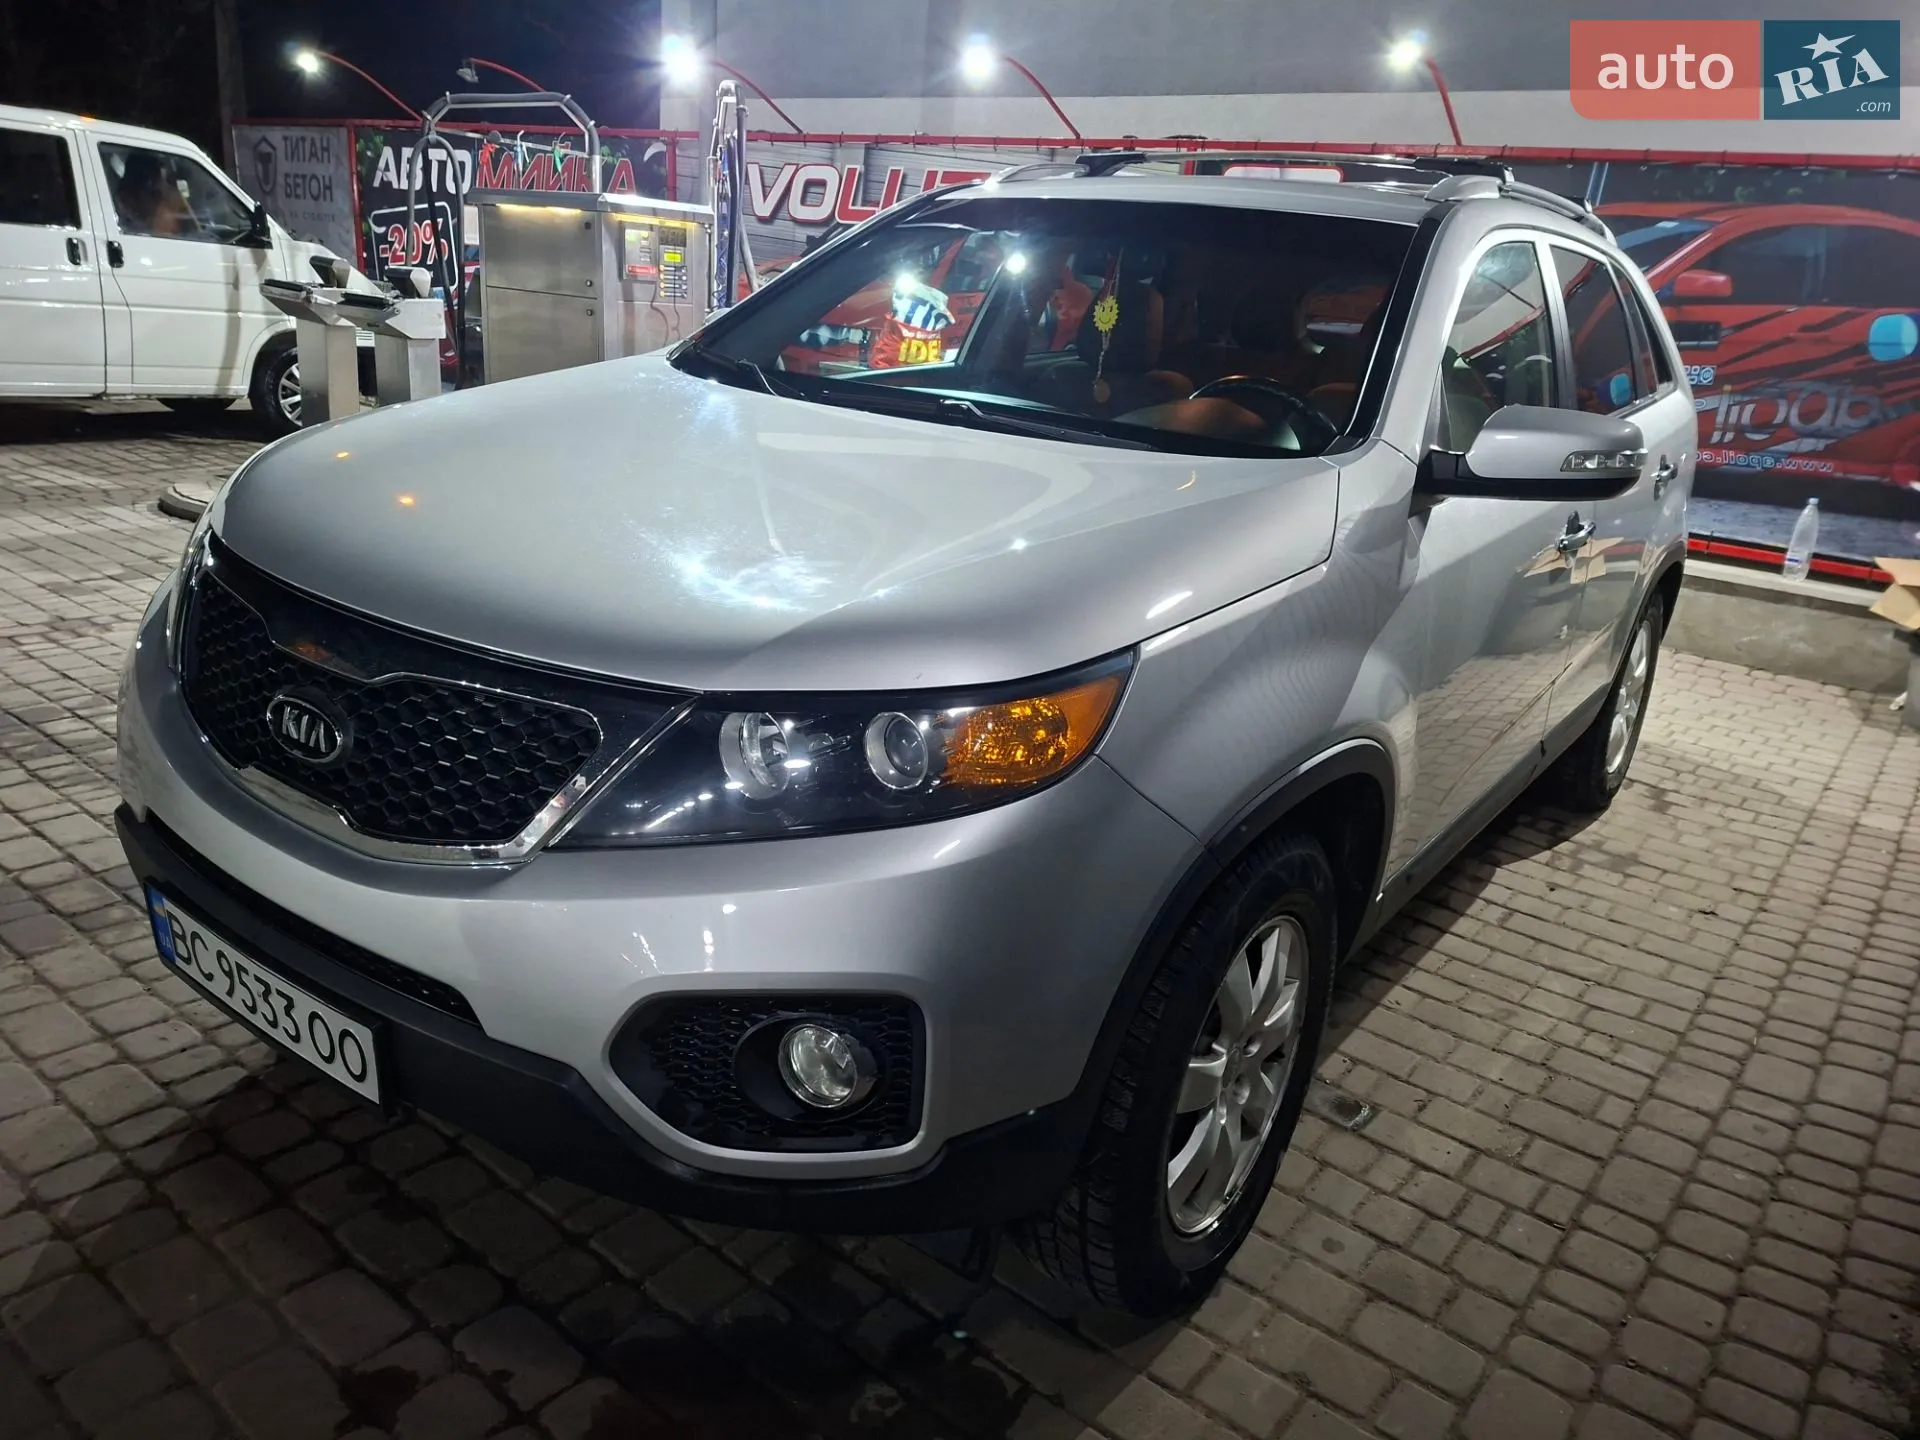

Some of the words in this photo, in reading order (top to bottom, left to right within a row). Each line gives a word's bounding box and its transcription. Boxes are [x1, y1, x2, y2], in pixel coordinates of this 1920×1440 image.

[282, 135, 331, 164] ТИТАН
[284, 173, 333, 202] БЕТОН
[379, 217, 449, 266] -20%
[281, 704, 326, 753] KIA
